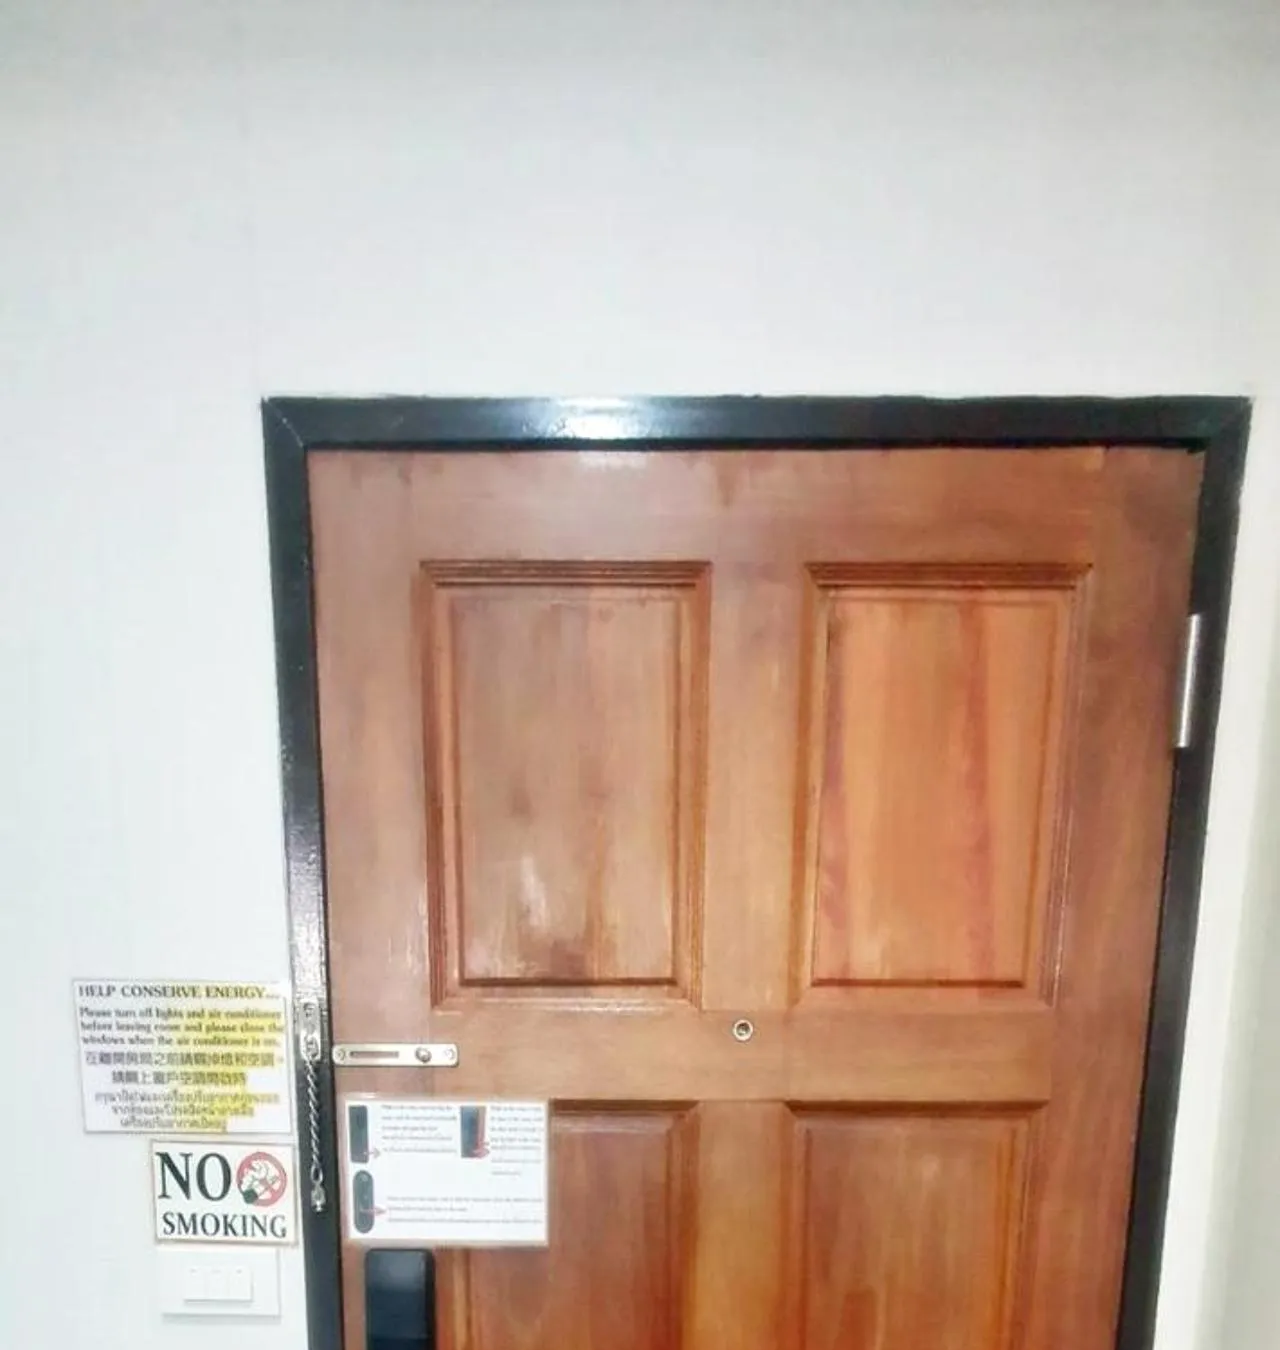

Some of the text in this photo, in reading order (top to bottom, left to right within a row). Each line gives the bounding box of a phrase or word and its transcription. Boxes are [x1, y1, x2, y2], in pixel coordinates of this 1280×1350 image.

[78, 985, 116, 997] HELP
[121, 985, 201, 997] CONSERVE
[79, 1007, 112, 1018] Please
[139, 1007, 153, 1018] off
[156, 1007, 183, 1020] lights
[186, 1008, 205, 1018] and
[208, 1008, 222, 1018] air
[80, 1021, 112, 1031] before
[116, 1021, 152, 1033] leaving
[184, 1022, 202, 1032] and
[206, 1022, 237, 1034] please
[240, 1022, 265, 1032] close
[268, 1022, 284, 1033] the
[81, 1034, 125, 1045] windows
[128, 1035, 154, 1045] when
[157, 1035, 174, 1045] the
[176, 1036, 190, 1046] air
[251, 1036, 260, 1046] is
[155, 1152, 232, 1201] NO
[162, 1211, 287, 1239] SMOKING
